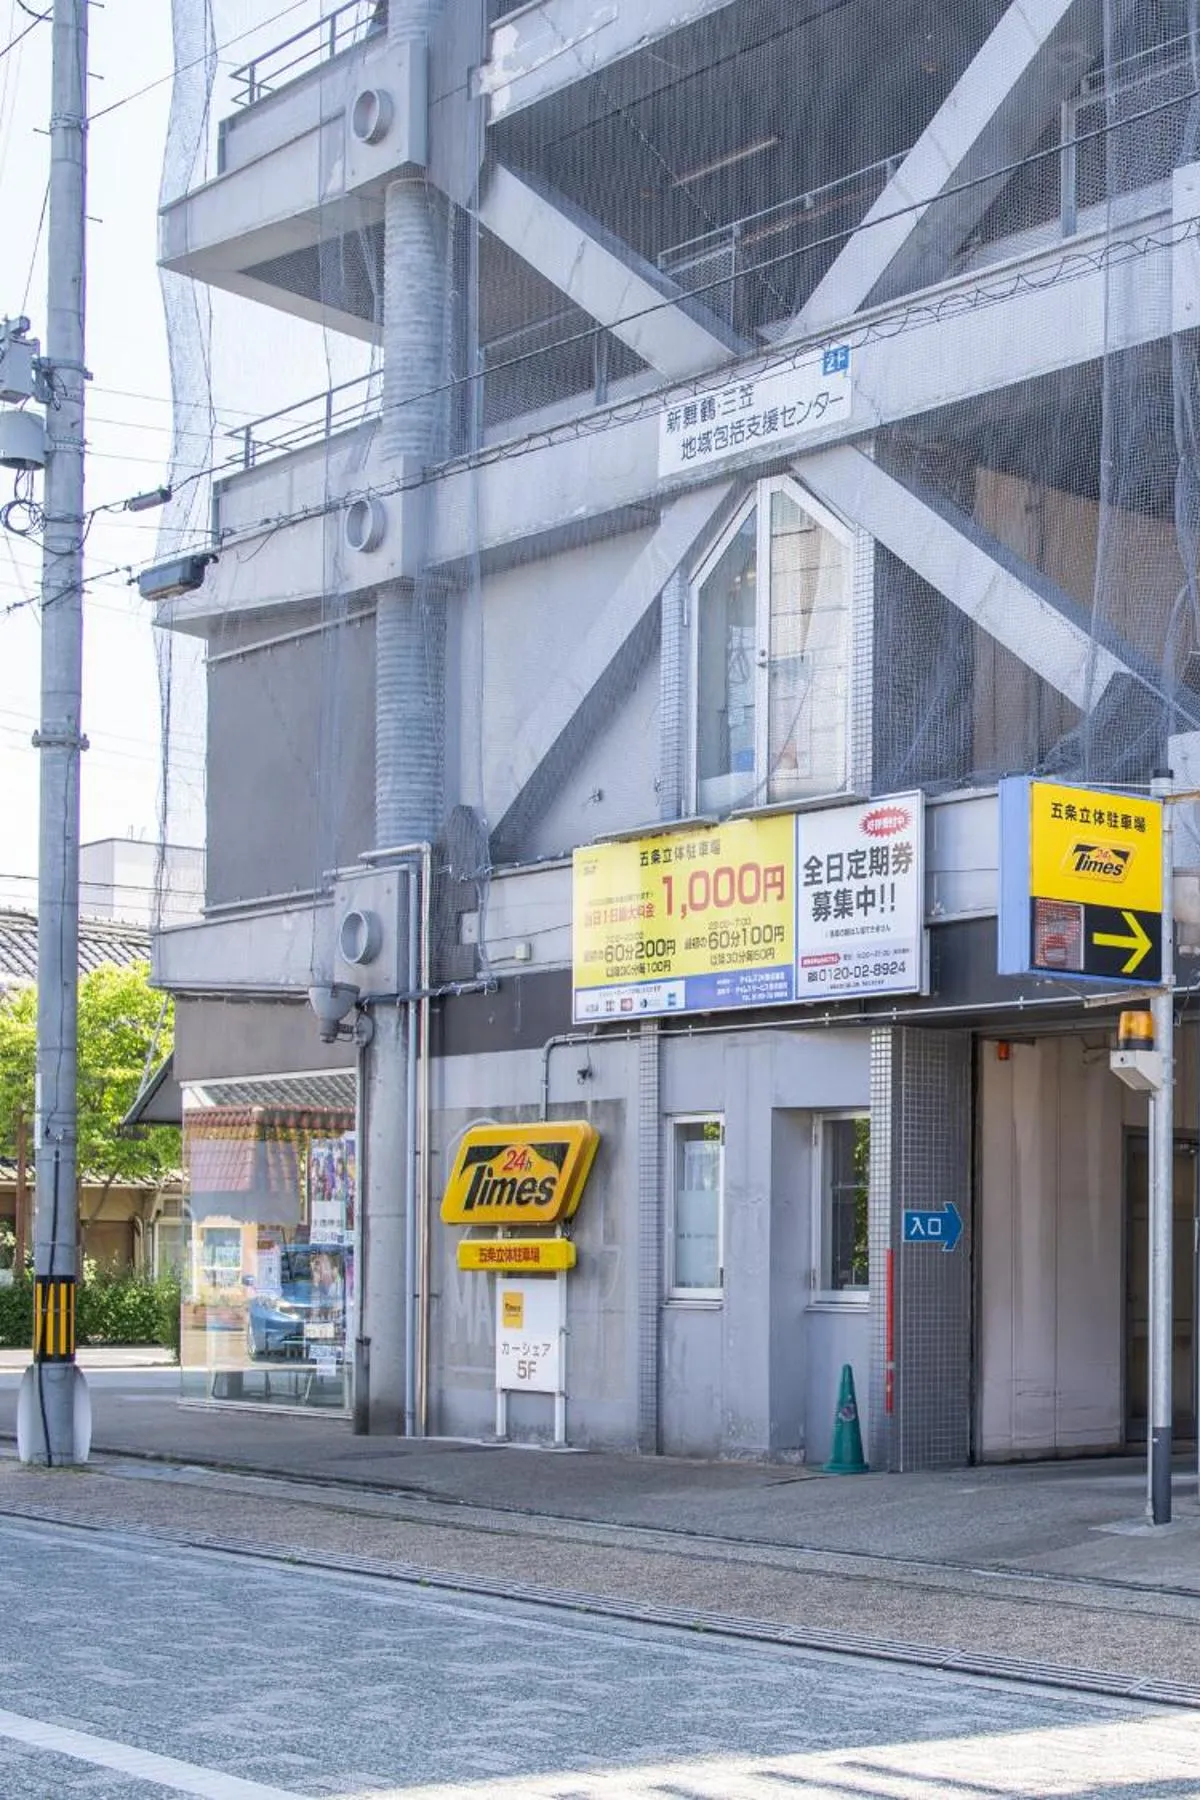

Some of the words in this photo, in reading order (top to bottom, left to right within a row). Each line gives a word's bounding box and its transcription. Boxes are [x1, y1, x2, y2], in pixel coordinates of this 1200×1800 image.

[825, 349, 848, 372] 2F
[681, 391, 844, 461] 地域包括支援センター
[1051, 802, 1146, 833] 五条立体駐車場
[640, 838, 721, 867] 五条立体駐車場
[802, 841, 914, 887] 全日定期券
[1073, 848, 1125, 876] Times
[662, 862, 785, 920] 1,000円
[819, 961, 906, 982] 0120-02-8924
[463, 1162, 558, 1211] Times
[910, 1217, 942, 1236] 入口
[479, 1246, 541, 1265] 五条立体駐車場
[501, 1342, 552, 1358] カーシェア
[516, 1359, 537, 1380] 5F
